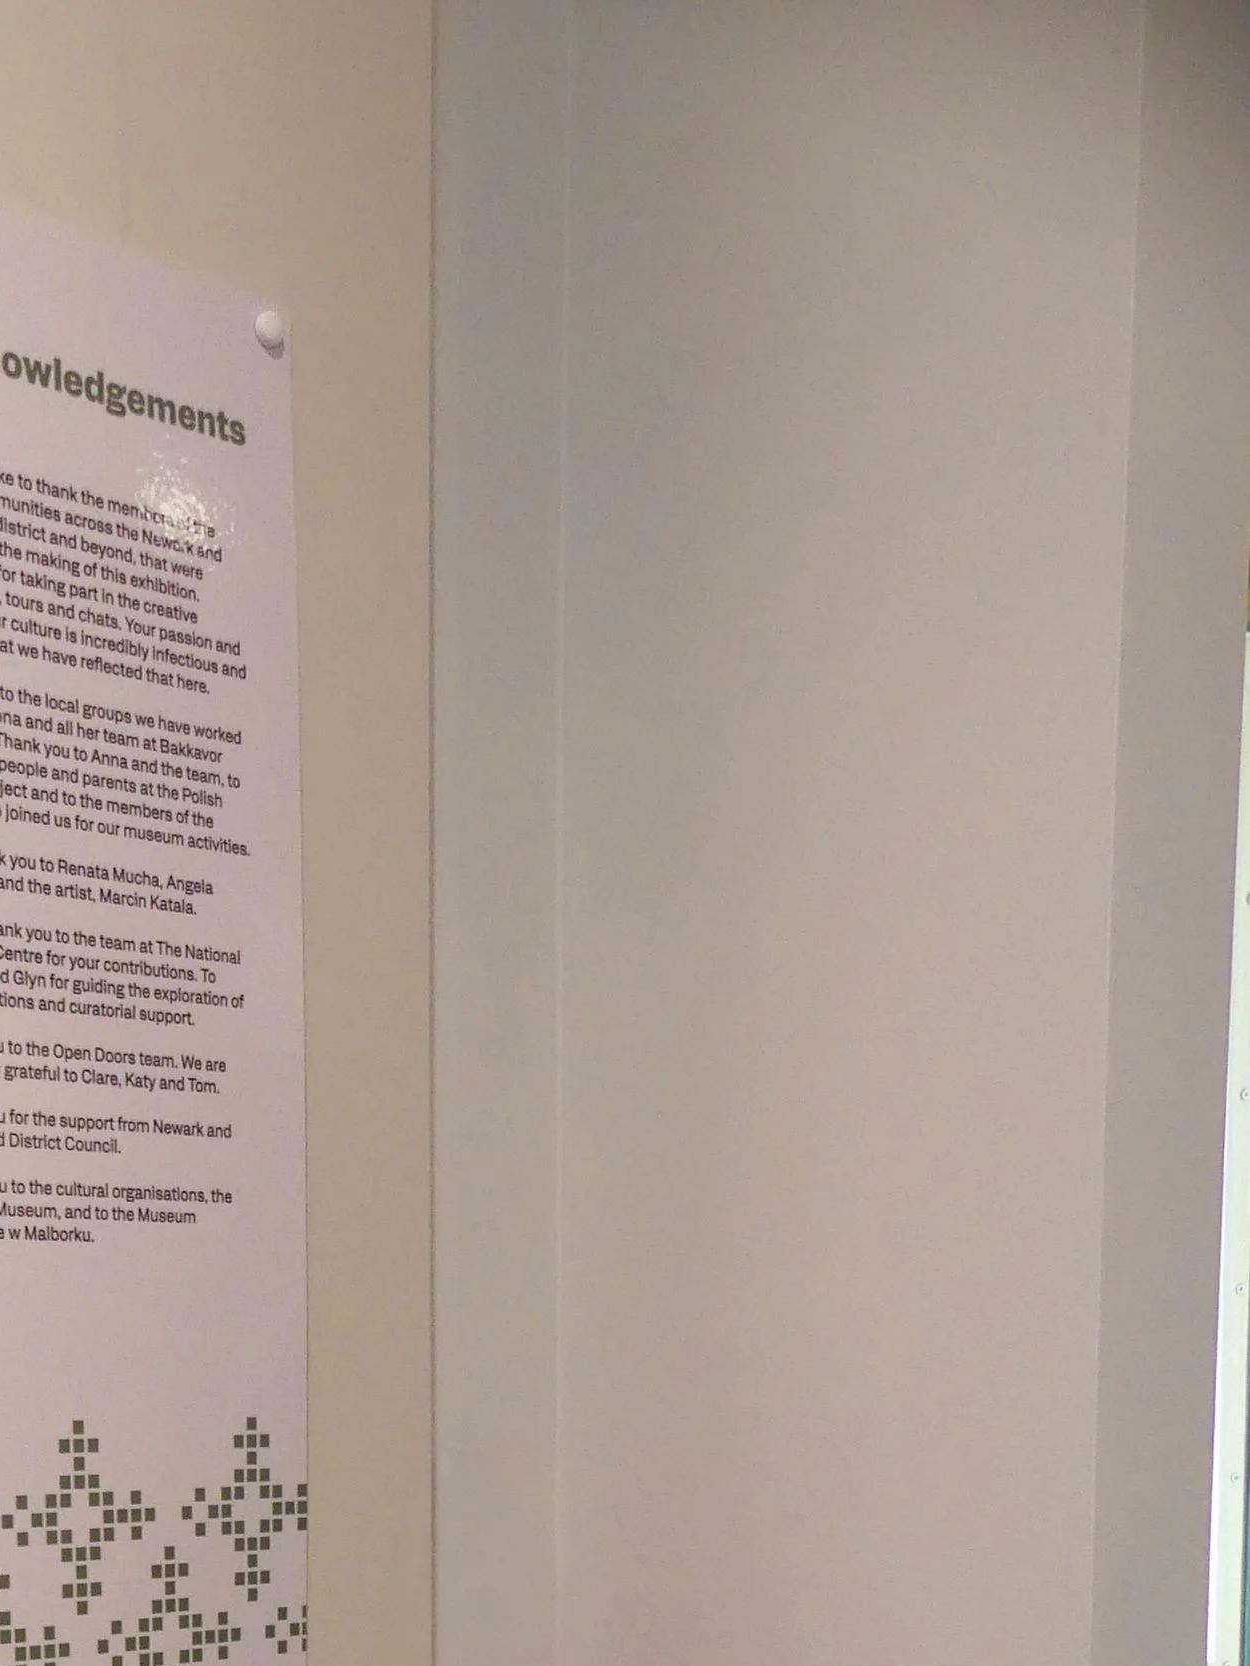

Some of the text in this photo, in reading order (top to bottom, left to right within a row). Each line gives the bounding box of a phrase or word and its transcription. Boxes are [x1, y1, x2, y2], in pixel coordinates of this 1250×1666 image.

[50, 532, 77, 549] and
[81, 536, 136, 565] beyond,
[140, 552, 167, 571] that
[171, 563, 203, 580] were
[27, 879, 51, 895] the
[55, 884, 96, 903] artist,
[100, 888, 146, 908] Marcin
[150, 895, 197, 915] Katala.
[39, 998, 65, 1012] and
[69, 1002, 136, 1019] curatorial
[140, 1009, 195, 1026] support.
[4, 1065, 60, 1081] grateful
[64, 1068, 78, 1083] to
[81, 1069, 121, 1088] Clare,
[125, 1073, 156, 1092] Katy
[159, 1077, 185, 1091] and
[188, 1077, 220, 1094] Tom.
[8, 1228, 21, 1240] w
[25, 1226, 94, 1242] Malborku.
